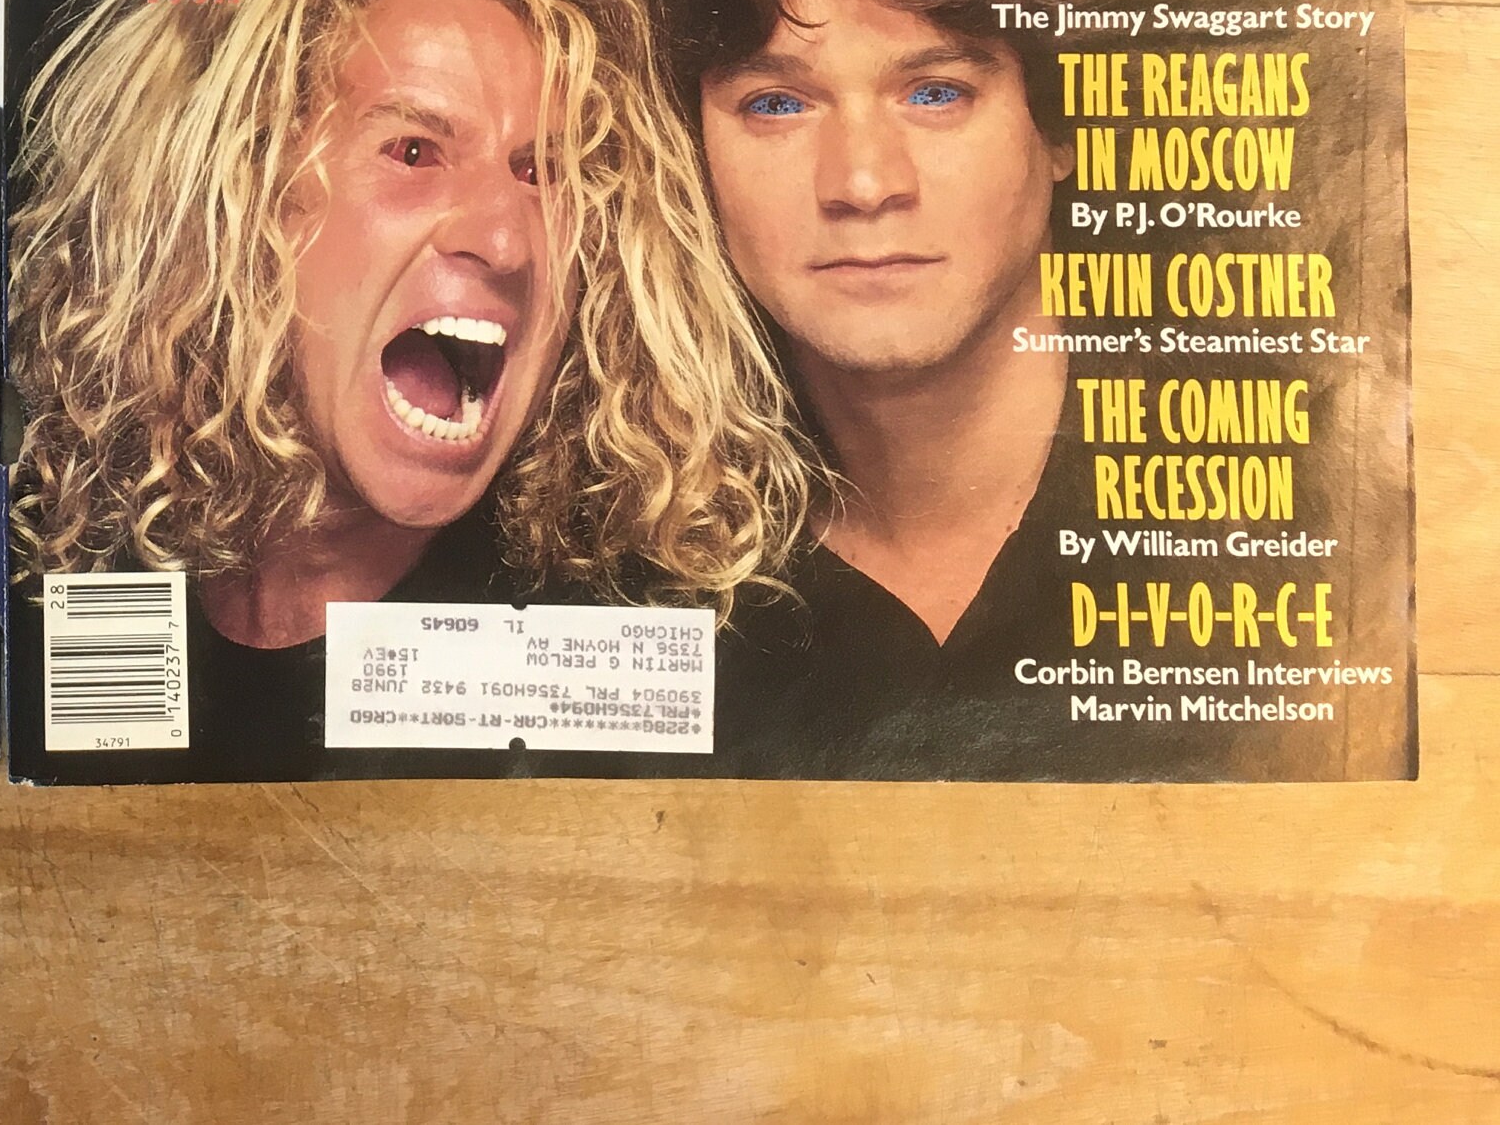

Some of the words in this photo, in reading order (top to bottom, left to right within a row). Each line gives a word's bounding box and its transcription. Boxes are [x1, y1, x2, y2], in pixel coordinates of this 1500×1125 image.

[991, 3, 1050, 29] The
[1054, 3, 1146, 37] Jimmy
[1152, 4, 1288, 37] Swaggart
[1296, 4, 1375, 37] Story
[1058, 53, 1129, 118] THE
[1142, 53, 1310, 118] REAGANS
[1076, 127, 1117, 191] IN
[1128, 127, 1295, 191] MOSCOW
[1071, 203, 1108, 235] By
[1116, 203, 1155, 235] P.J.
[1160, 203, 1302, 229] O'Rourke
[1040, 252, 1153, 318] KEVIN
[1166, 252, 1336, 318] COSTNER
[1012, 327, 1152, 354] Summer's
[1160, 328, 1304, 355] Steamiest
[1310, 328, 1371, 355] Star
[1077, 379, 1147, 444] THE
[1159, 379, 1310, 445] COMING
[1094, 454, 1294, 520] RECESSION
[1059, 530, 1096, 564] By
[1102, 530, 1218, 558] William
[1226, 530, 1339, 558] Greider
[50, 584, 65, 609] 28
[1071, 582, 1333, 648] D-I-V-O-R-C-E
[420, 617, 480, 632] 60645
[503, 619, 525, 634] IL
[620, 624, 703, 641] CHICAGO
[527, 637, 549, 651] AV
[563, 638, 620, 653] HOYNE
[631, 640, 644, 654] N
[656, 641, 703, 657] 7356
[363, 663, 407, 677] 1990
[526, 653, 598, 670] PERLOW
[609, 655, 620, 670] G
[631, 656, 703, 672] MARTIN
[167, 644, 181, 713] 140237
[1014, 658, 1114, 684] Corbin
[1122, 659, 1240, 685] Bernsen
[1247, 659, 1393, 685] Interviews
[350, 678, 409, 694] JUN28
[422, 680, 467, 695] 9432
[586, 686, 620, 701] PRL
[631, 687, 702, 704] 390904
[1071, 695, 1172, 722] Marvin
[1181, 695, 1334, 722] Mitchelson
[95, 737, 130, 748] 34791
